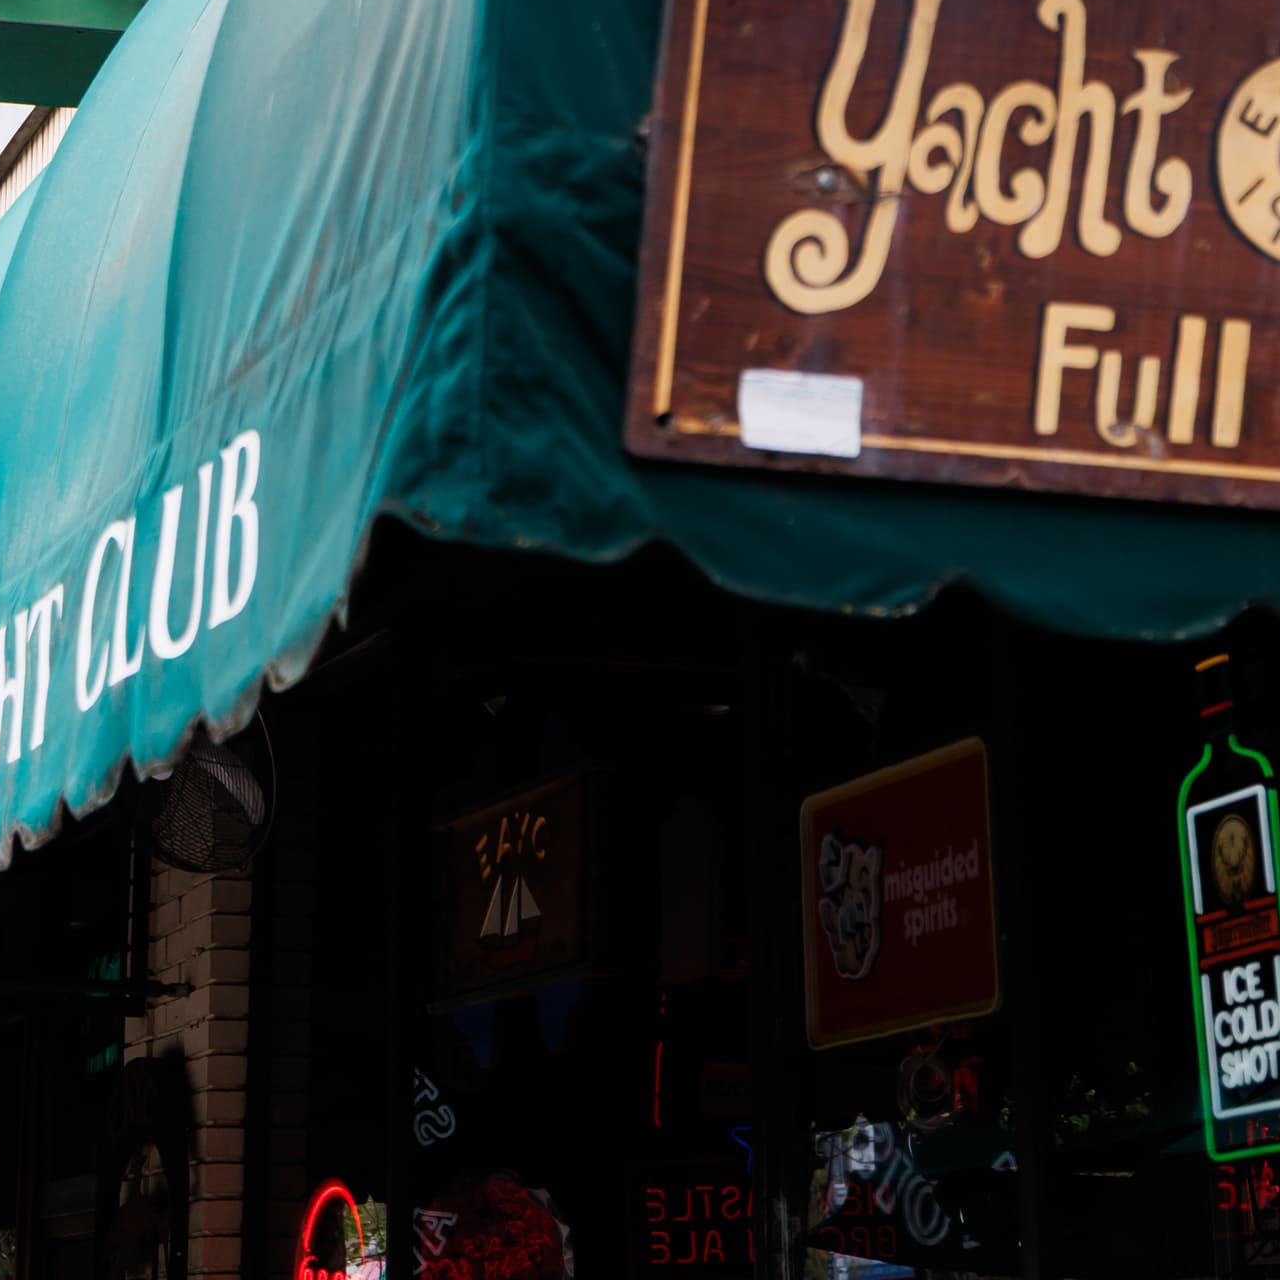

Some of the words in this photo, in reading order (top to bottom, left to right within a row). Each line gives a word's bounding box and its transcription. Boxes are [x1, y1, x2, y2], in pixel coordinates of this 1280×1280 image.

[1034, 303, 1251, 448] Full
[74, 428, 262, 713] CLUB
[883, 837, 980, 904] misguided
[904, 891, 958, 949] spirits
[1221, 960, 1266, 1007] ICE
